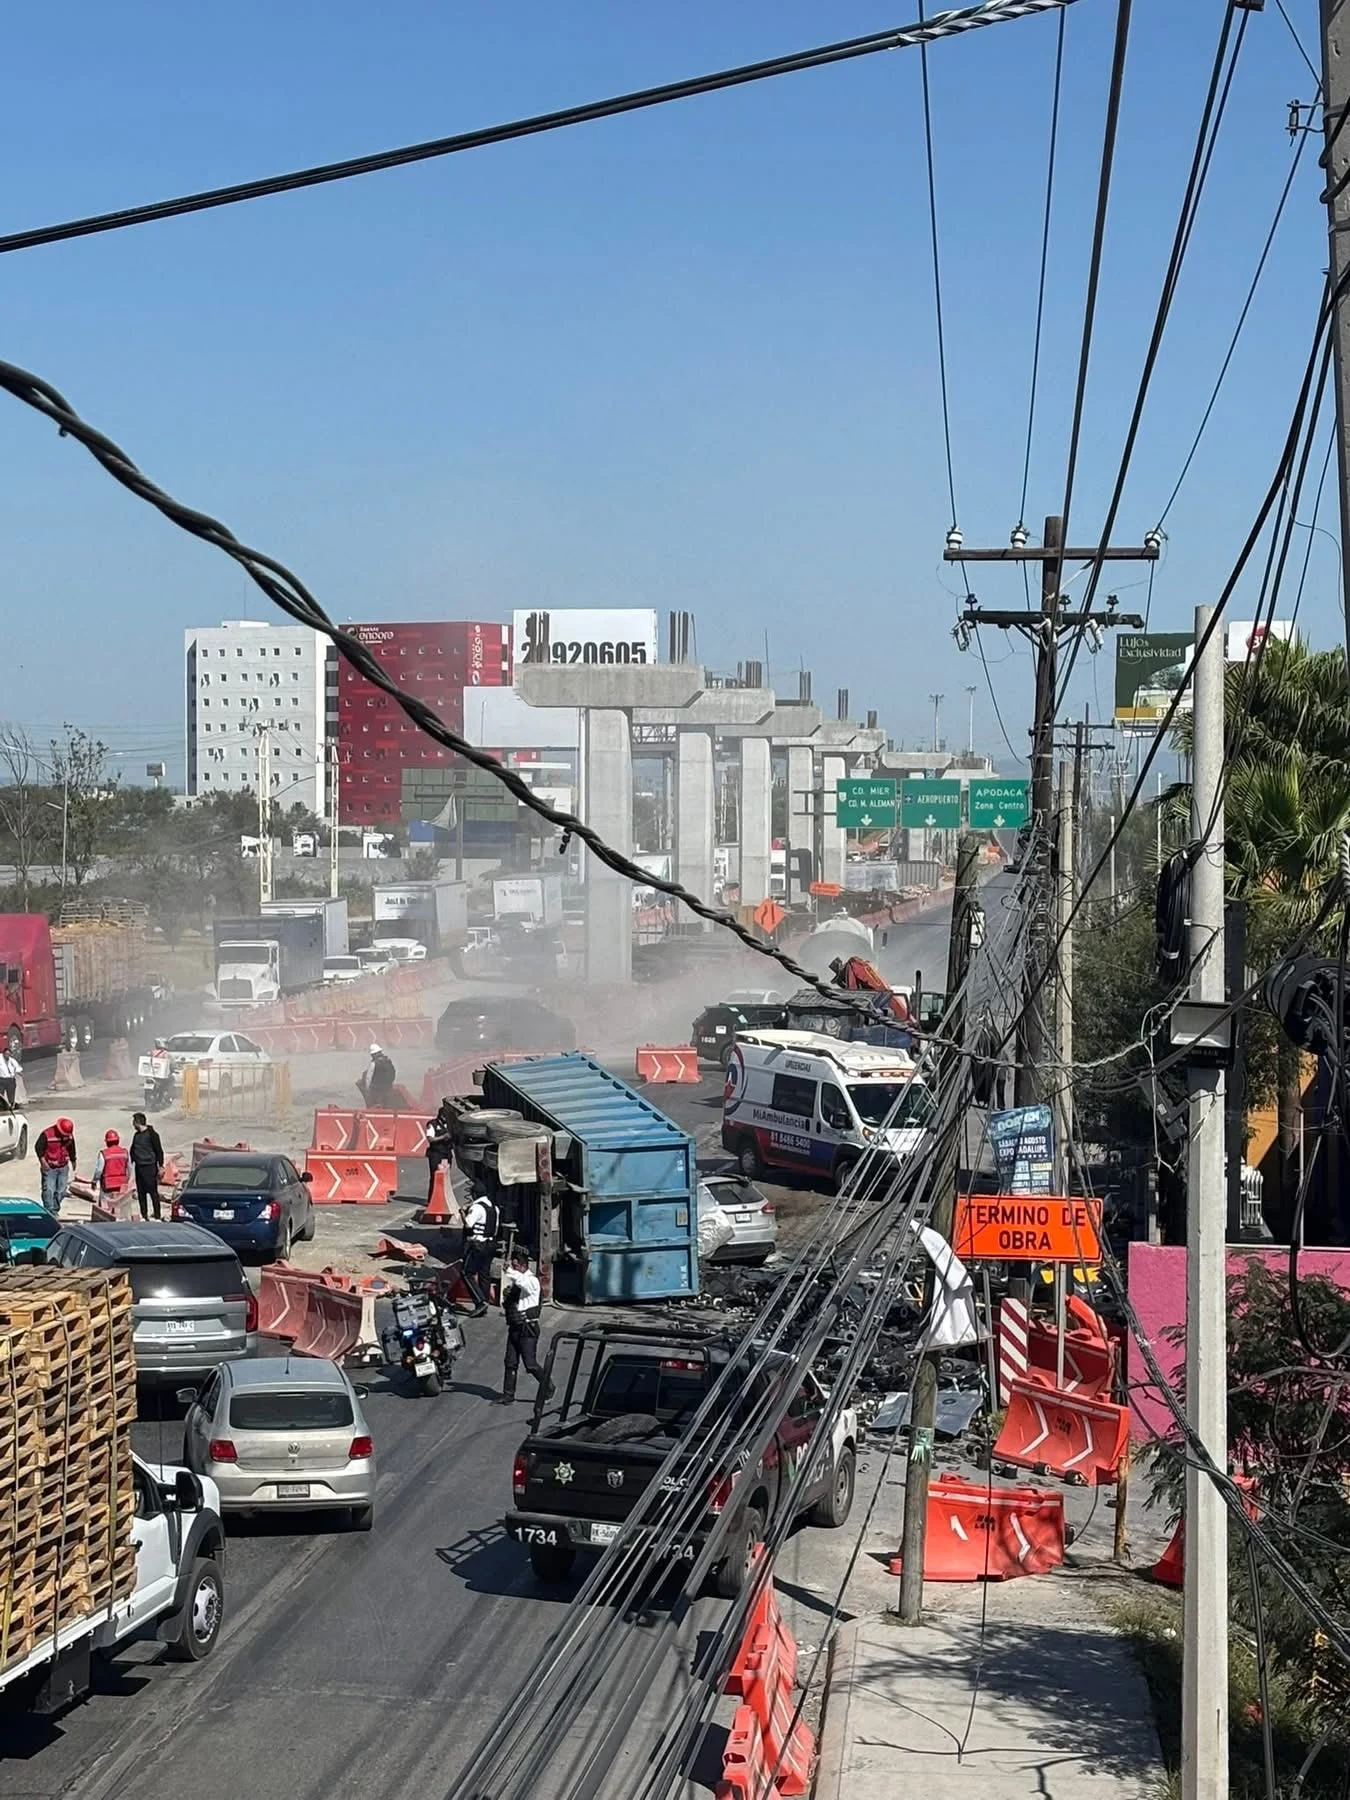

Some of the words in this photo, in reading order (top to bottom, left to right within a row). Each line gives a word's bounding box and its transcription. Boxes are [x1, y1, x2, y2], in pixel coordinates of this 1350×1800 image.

[521, 641, 647, 664] 2920605
[870, 786, 890, 796] MIER
[975, 788, 1023, 797] APODACA
[917, 795, 959, 805] AEROPUERTO
[974, 801, 994, 810] Zona
[998, 801, 1025, 810] Centro
[752, 1108, 806, 1131] MiAmbulancia
[1024, 1136, 1046, 1145] AGOSTO
[1000, 1147, 1015, 1156] EXPO
[1016, 1145, 1048, 1154] ADALUPE
[966, 1205, 1049, 1226] TERMINO
[1061, 1208, 1086, 1227] DE
[999, 1230, 1052, 1250] OBRA
[514, 1527, 558, 1546] 1734
